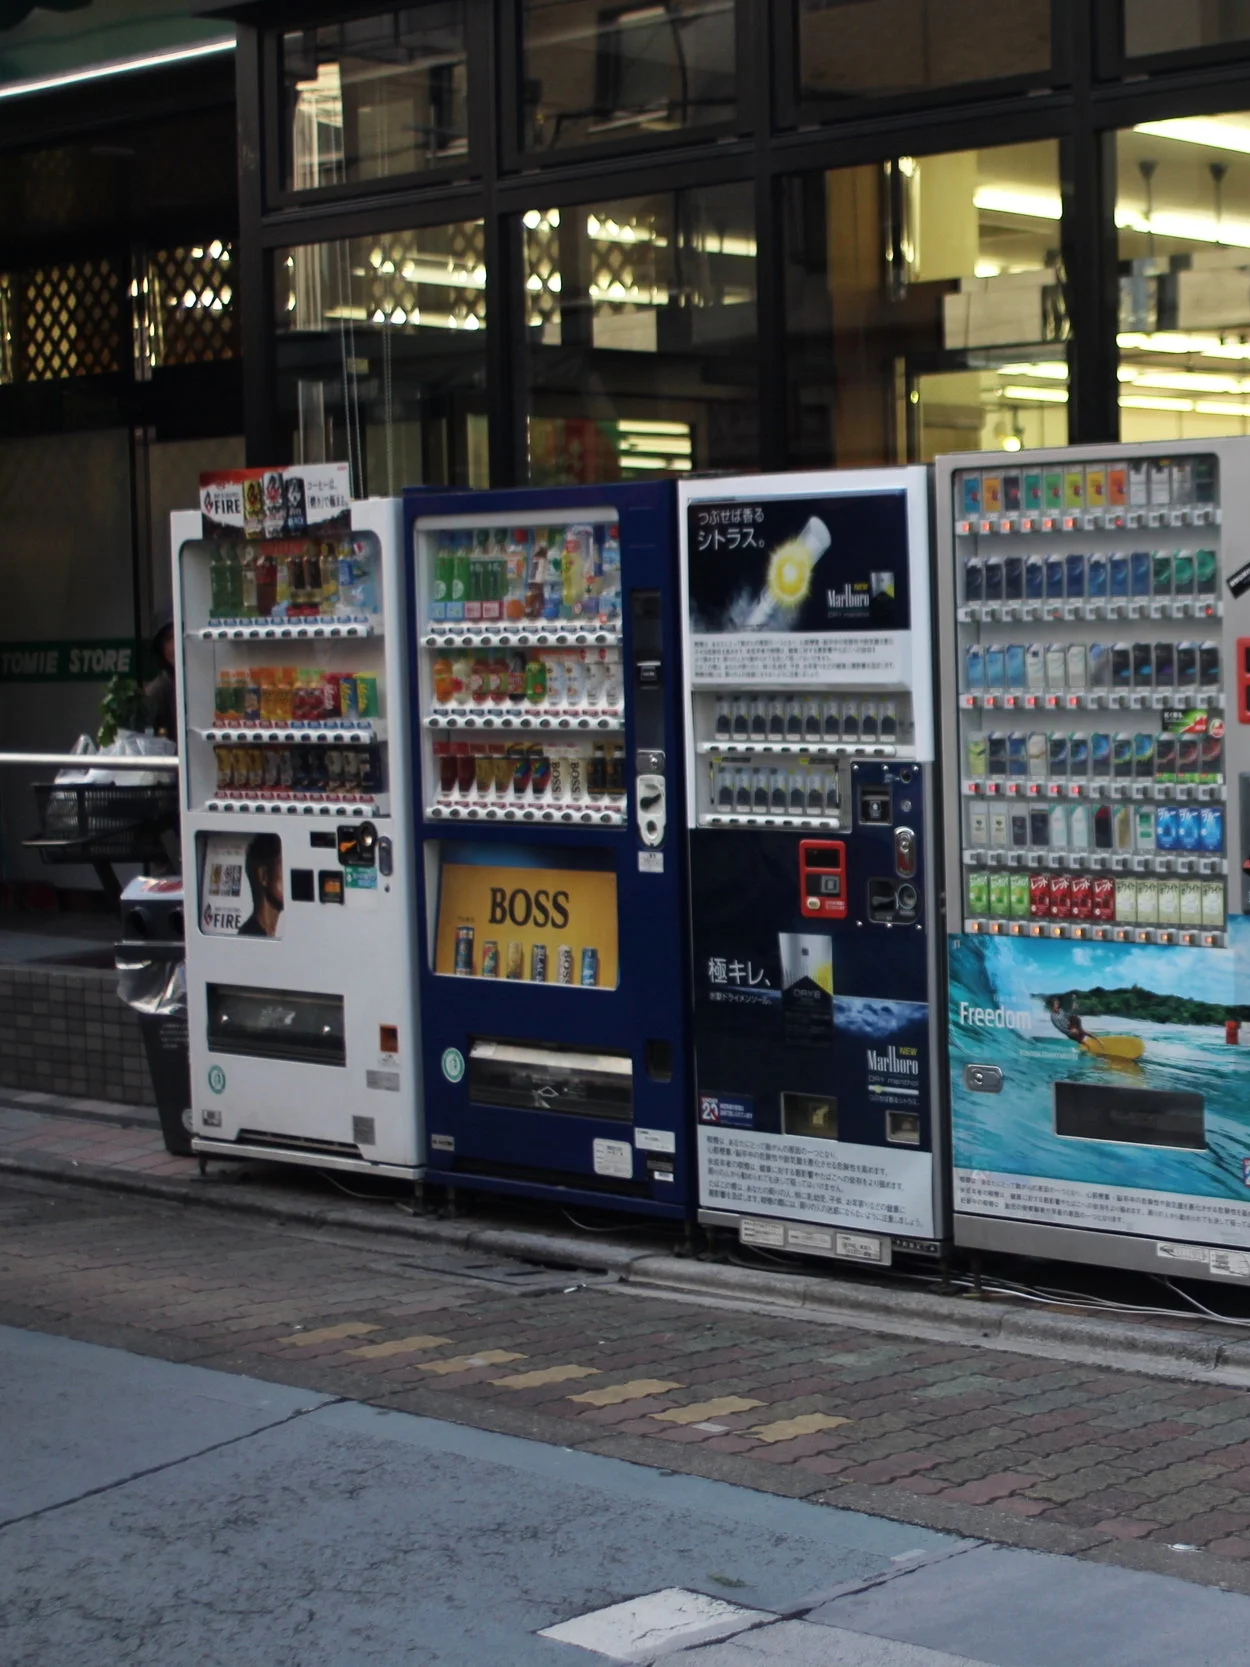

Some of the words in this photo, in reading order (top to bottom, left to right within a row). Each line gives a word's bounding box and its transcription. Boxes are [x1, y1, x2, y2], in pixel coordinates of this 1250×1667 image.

[214, 499, 241, 514] FIRE
[698, 508, 765, 525] つぶせば香る
[698, 528, 765, 550] シトラス。
[827, 583, 870, 609] Marlboro
[1, 649, 58, 674] TOMIE
[69, 648, 132, 674] STORE
[551, 760, 561, 793] BOSS
[570, 762, 581, 794] BOSS
[213, 913, 242, 929] FIRE
[488, 887, 570, 929] BOSS
[708, 957, 771, 985] 極キレ、
[960, 1001, 1032, 1029] Freedom
[867, 1045, 919, 1075] Marlboro
